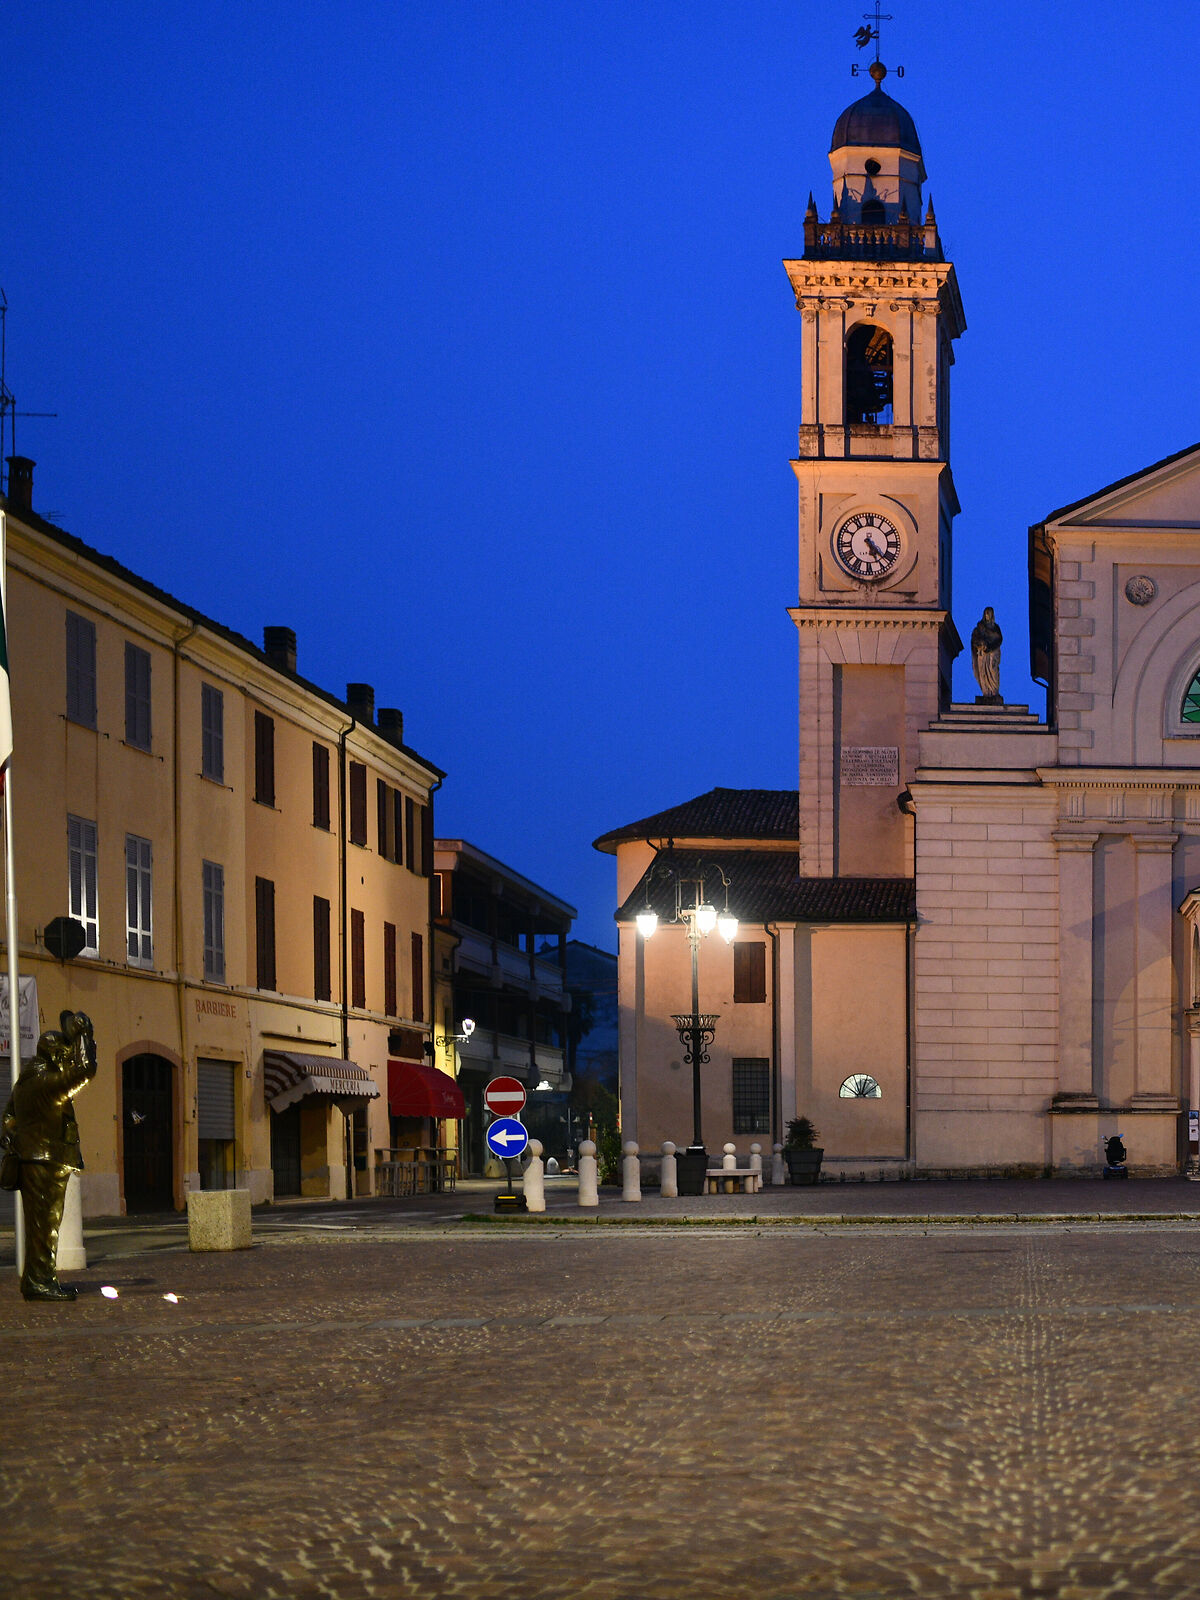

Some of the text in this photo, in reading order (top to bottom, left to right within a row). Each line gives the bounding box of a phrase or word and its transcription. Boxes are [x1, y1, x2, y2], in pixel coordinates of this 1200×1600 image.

[851, 64, 859, 77] E
[897, 65, 905, 78] O
[195, 999, 237, 1019] BARBIERE
